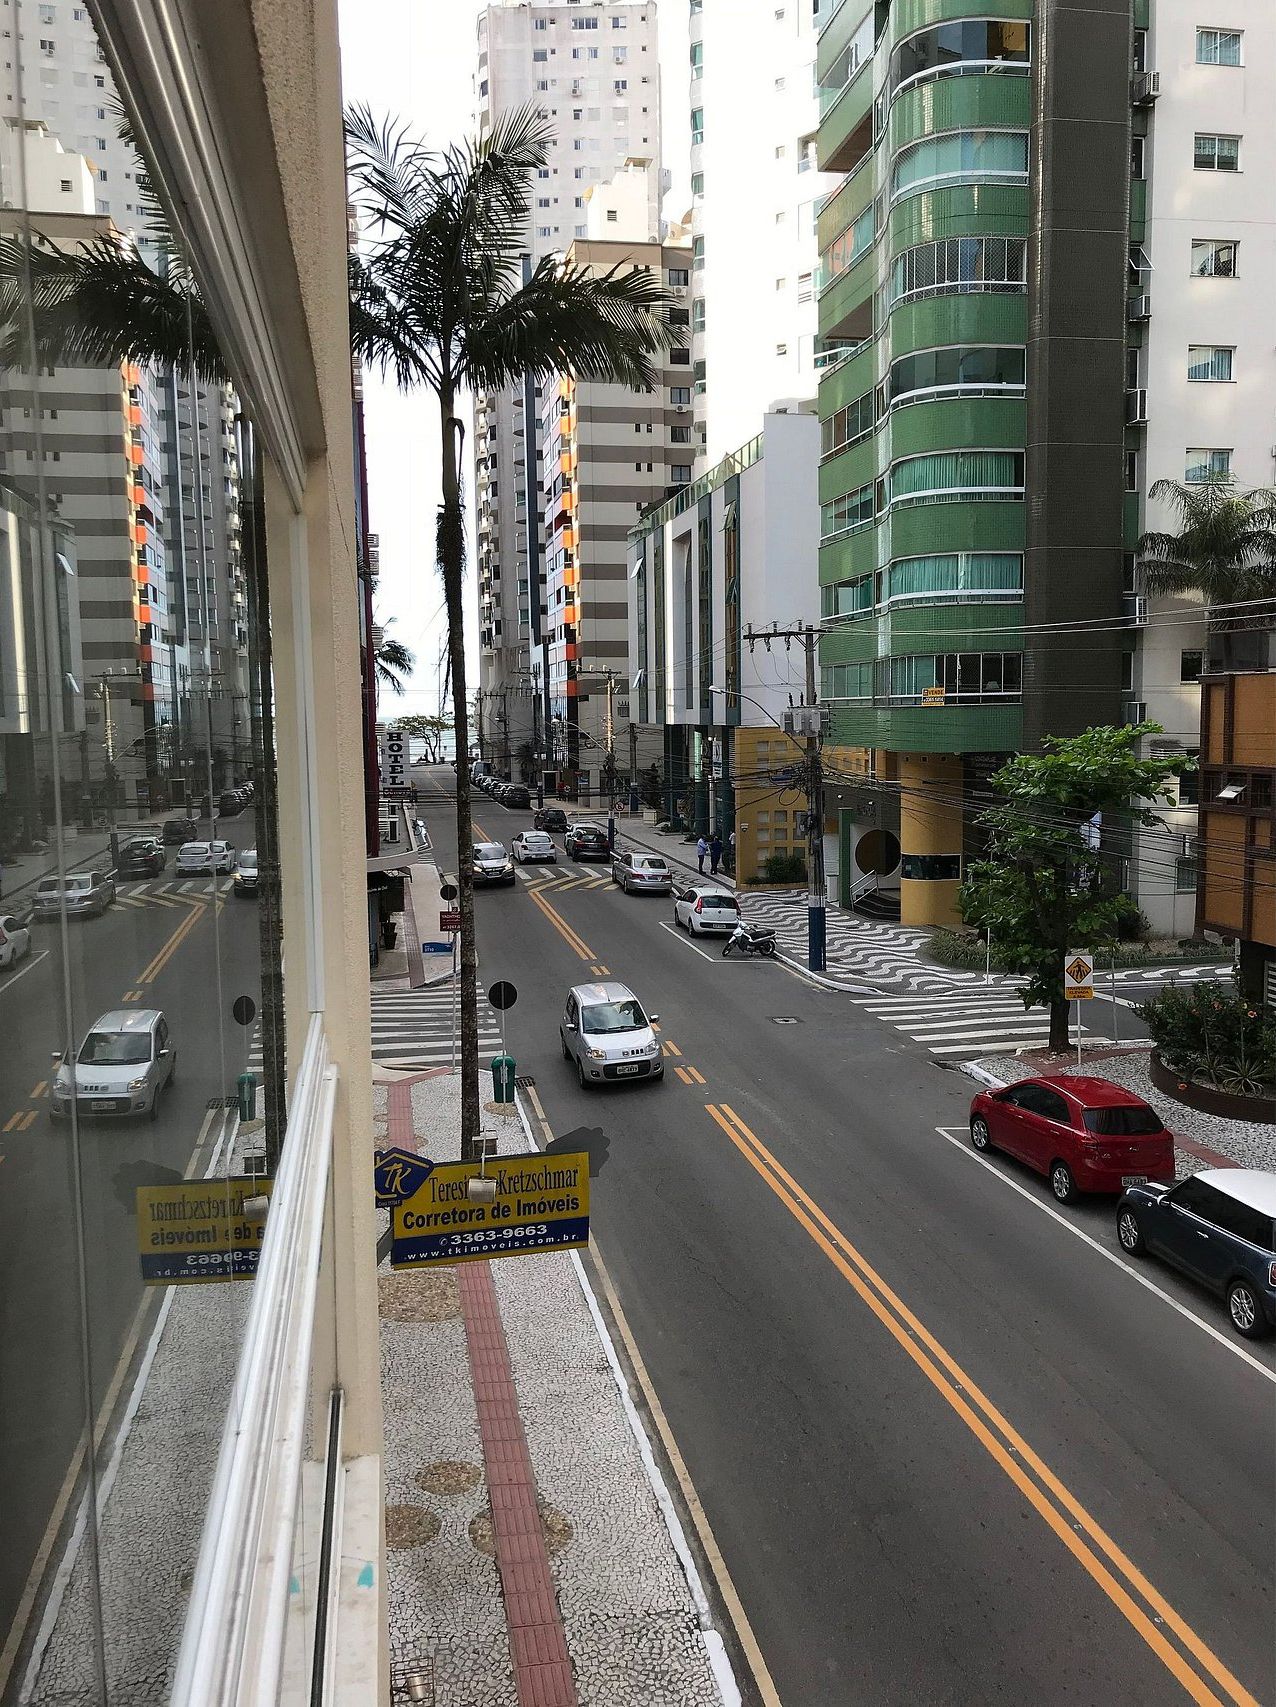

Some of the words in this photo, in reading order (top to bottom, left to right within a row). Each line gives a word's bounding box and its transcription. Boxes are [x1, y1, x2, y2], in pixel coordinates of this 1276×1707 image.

[387, 732, 404, 785] HOTEL
[382, 1162, 412, 1195] TK
[429, 1173, 497, 1203] Teresi
[498, 1165, 579, 1196] Kretzschmar
[403, 1206, 486, 1230] Corretora
[491, 1201, 512, 1219] de
[517, 1194, 580, 1217] Imóveis
[407, 1234, 577, 1260] www.tkimoveis.com.br
[450, 1224, 548, 1245] 3363-9663
